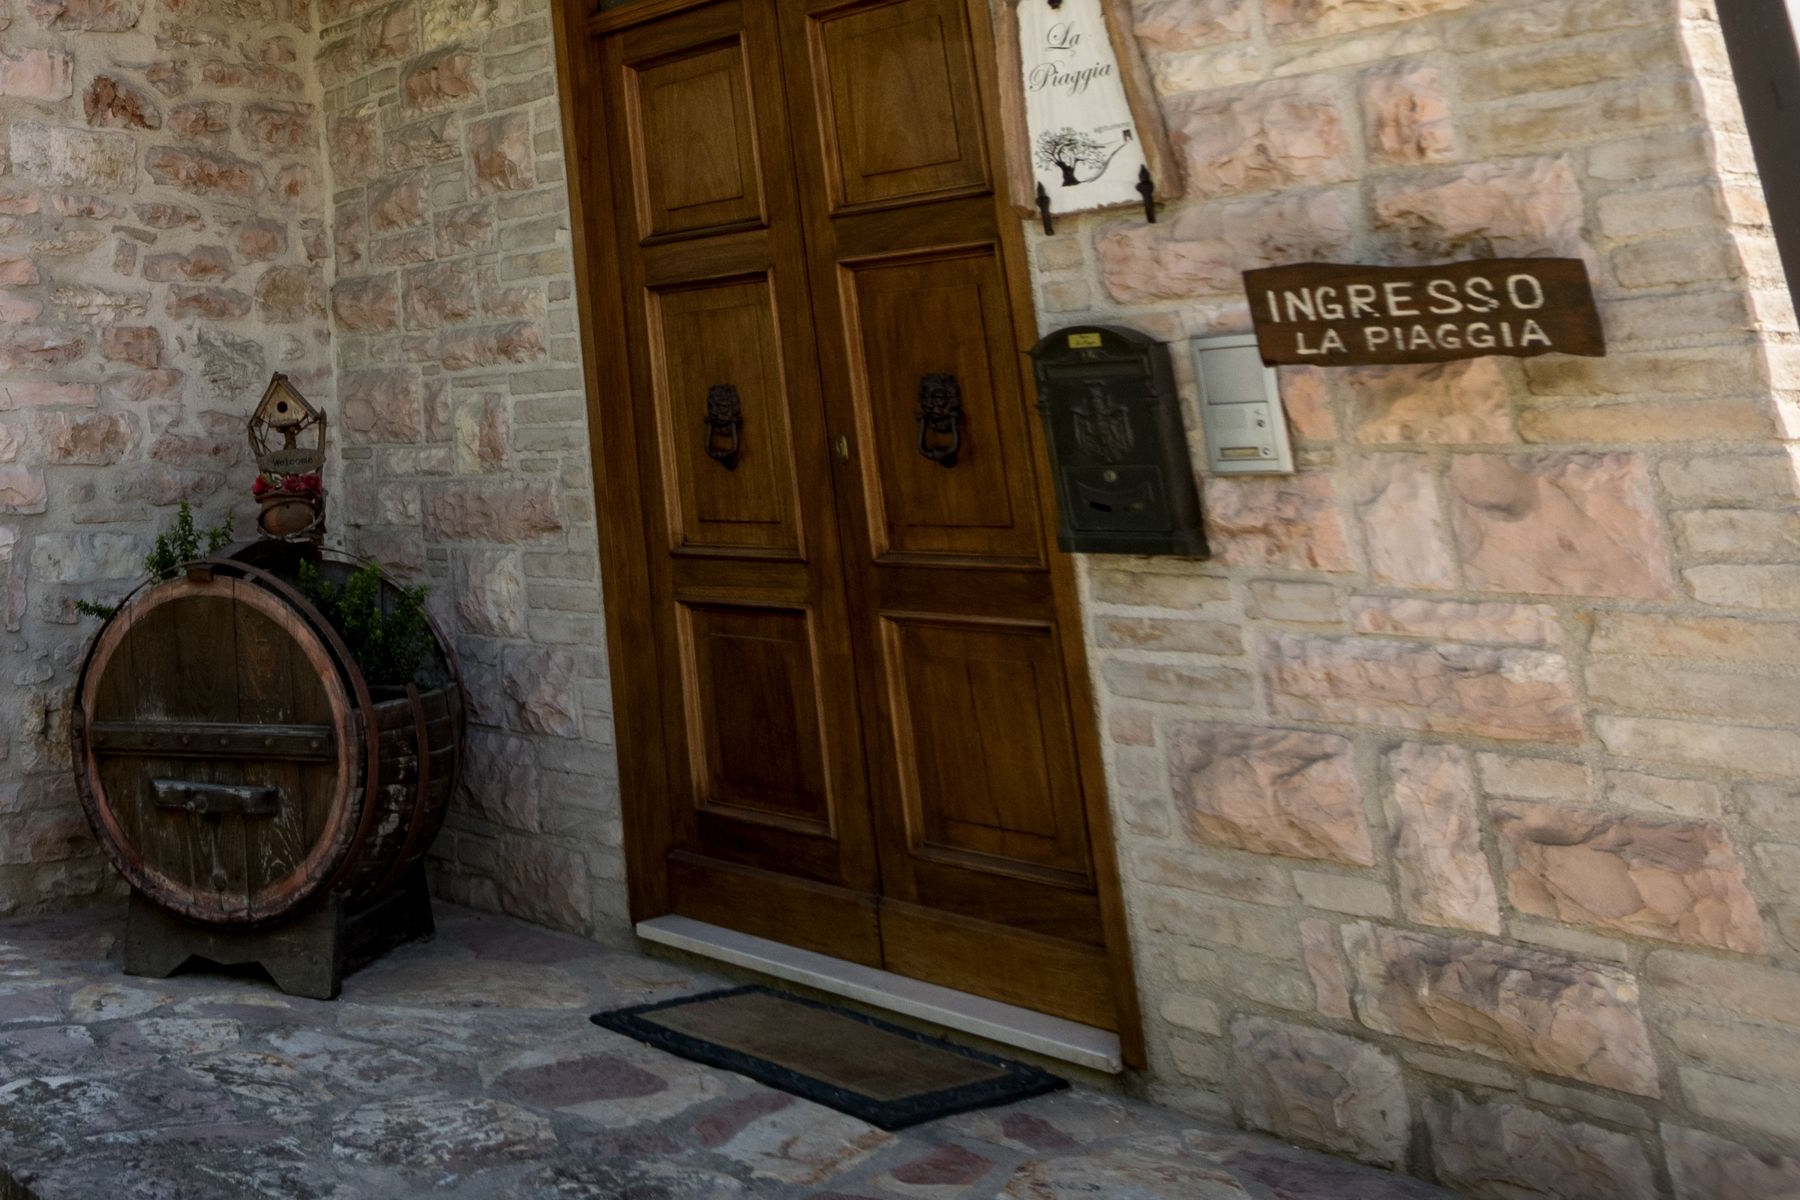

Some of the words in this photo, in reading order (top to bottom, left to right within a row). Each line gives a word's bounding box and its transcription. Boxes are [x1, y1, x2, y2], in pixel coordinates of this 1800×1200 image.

[1045, 21, 1081, 51] La
[1029, 60, 1111, 97] Piaggia
[1266, 274, 1545, 323] INGRESSO
[1296, 328, 1349, 355] LA
[1363, 319, 1553, 351] PIAGGIA
[273, 456, 313, 467] Welcome
